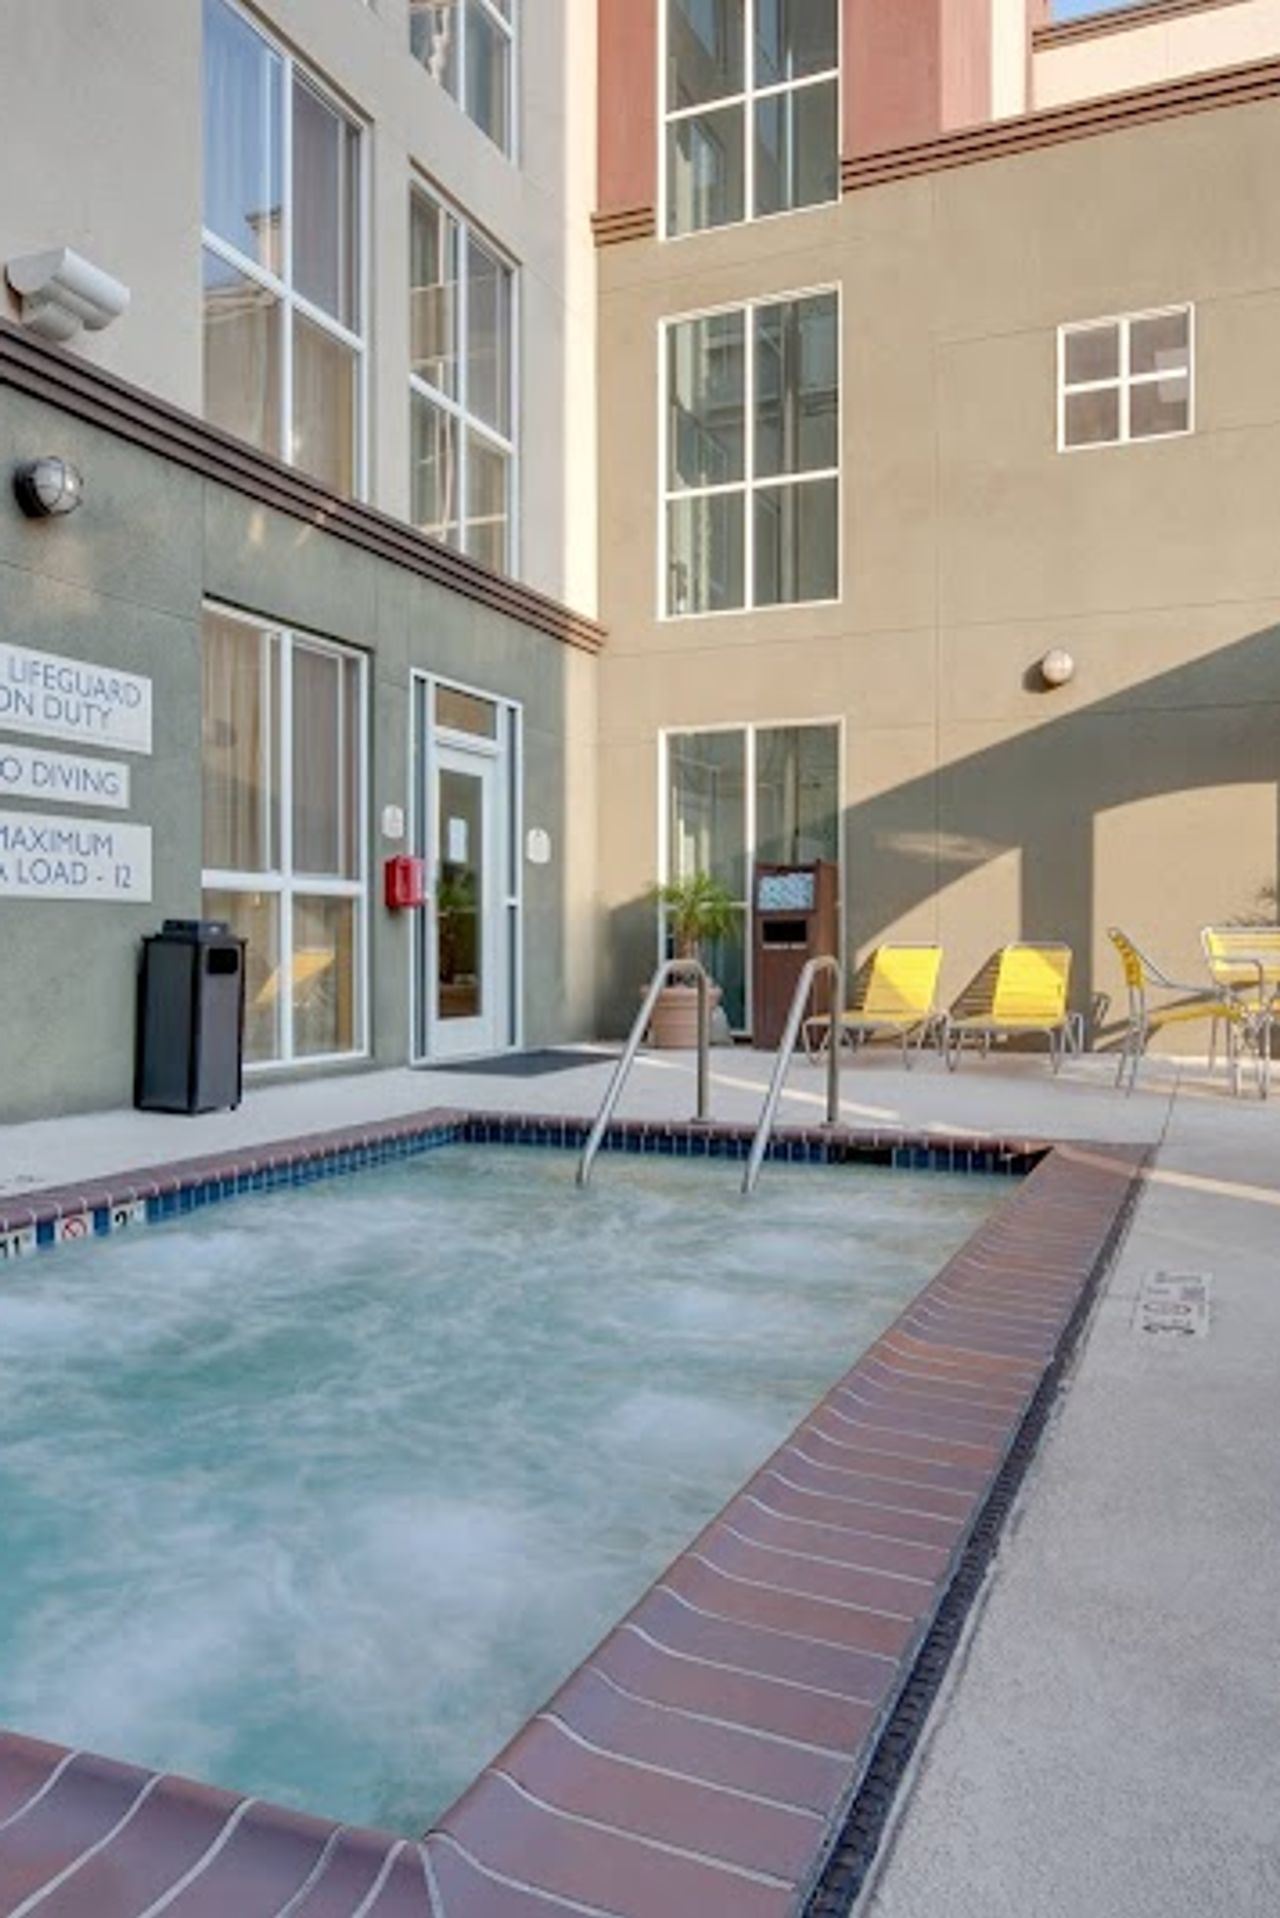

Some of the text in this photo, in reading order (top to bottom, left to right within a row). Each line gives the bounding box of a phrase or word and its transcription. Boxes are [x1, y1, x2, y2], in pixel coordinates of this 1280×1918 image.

[9, 656, 141, 708] LIFEGUARD
[43, 696, 112, 730] DUTY
[0, 757, 119, 795] O DIVING
[18, 858, 87, 885] LOAD
[114, 864, 131, 889] 12
